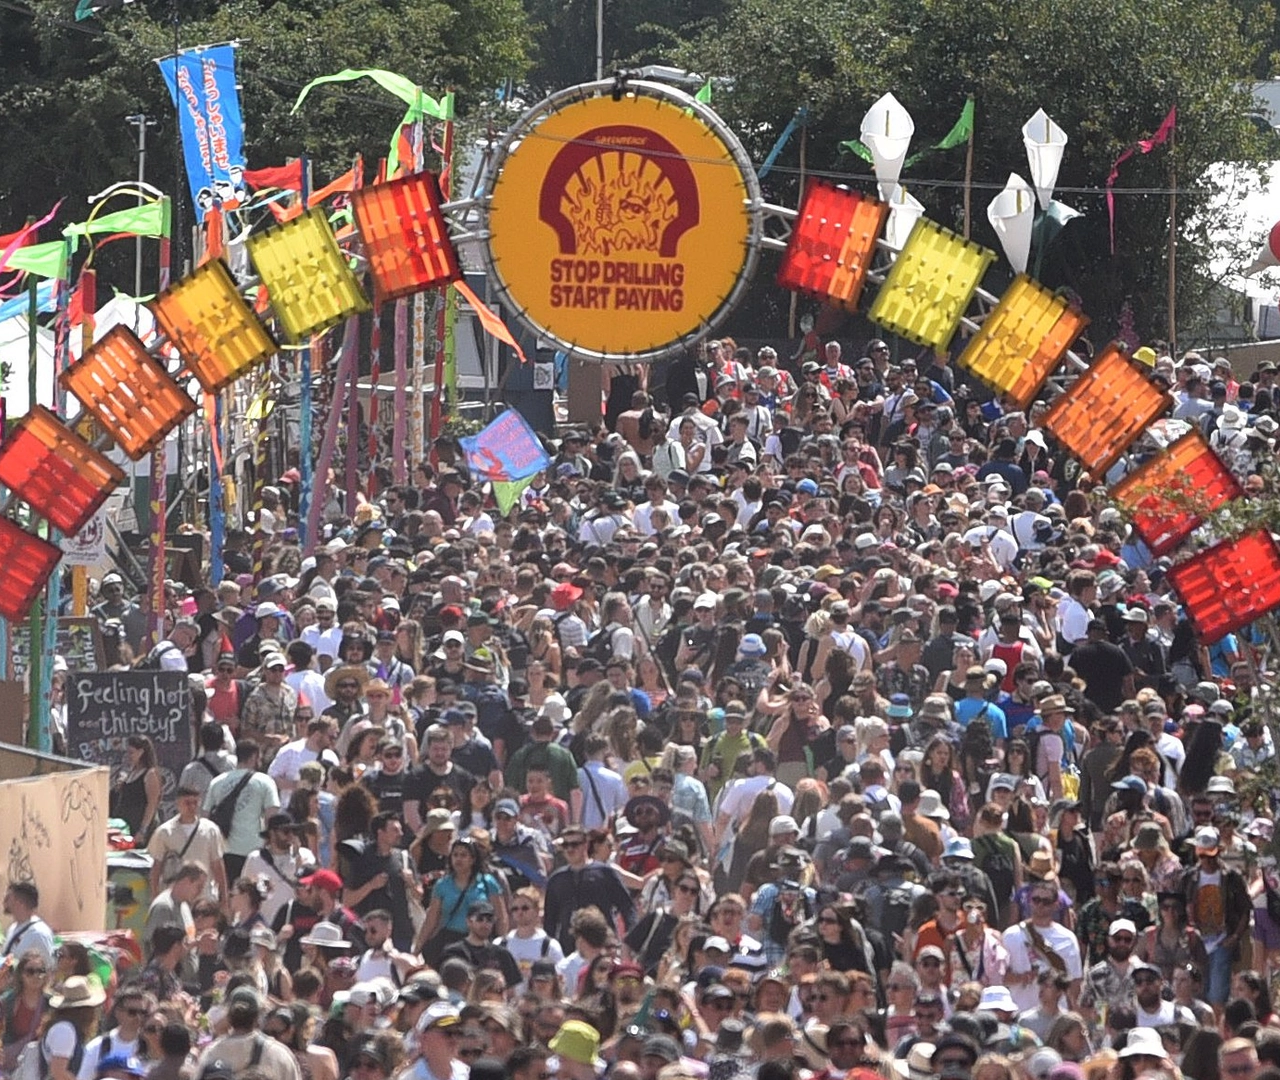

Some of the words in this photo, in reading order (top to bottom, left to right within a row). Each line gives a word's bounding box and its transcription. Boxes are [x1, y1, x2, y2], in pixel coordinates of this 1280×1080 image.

[550, 259, 601, 283] STOP
[603, 261, 684, 287] DRILLING
[550, 286, 610, 309] START
[615, 287, 684, 312] PAYING
[77, 678, 152, 715] feeling
[154, 676, 189, 710] hot
